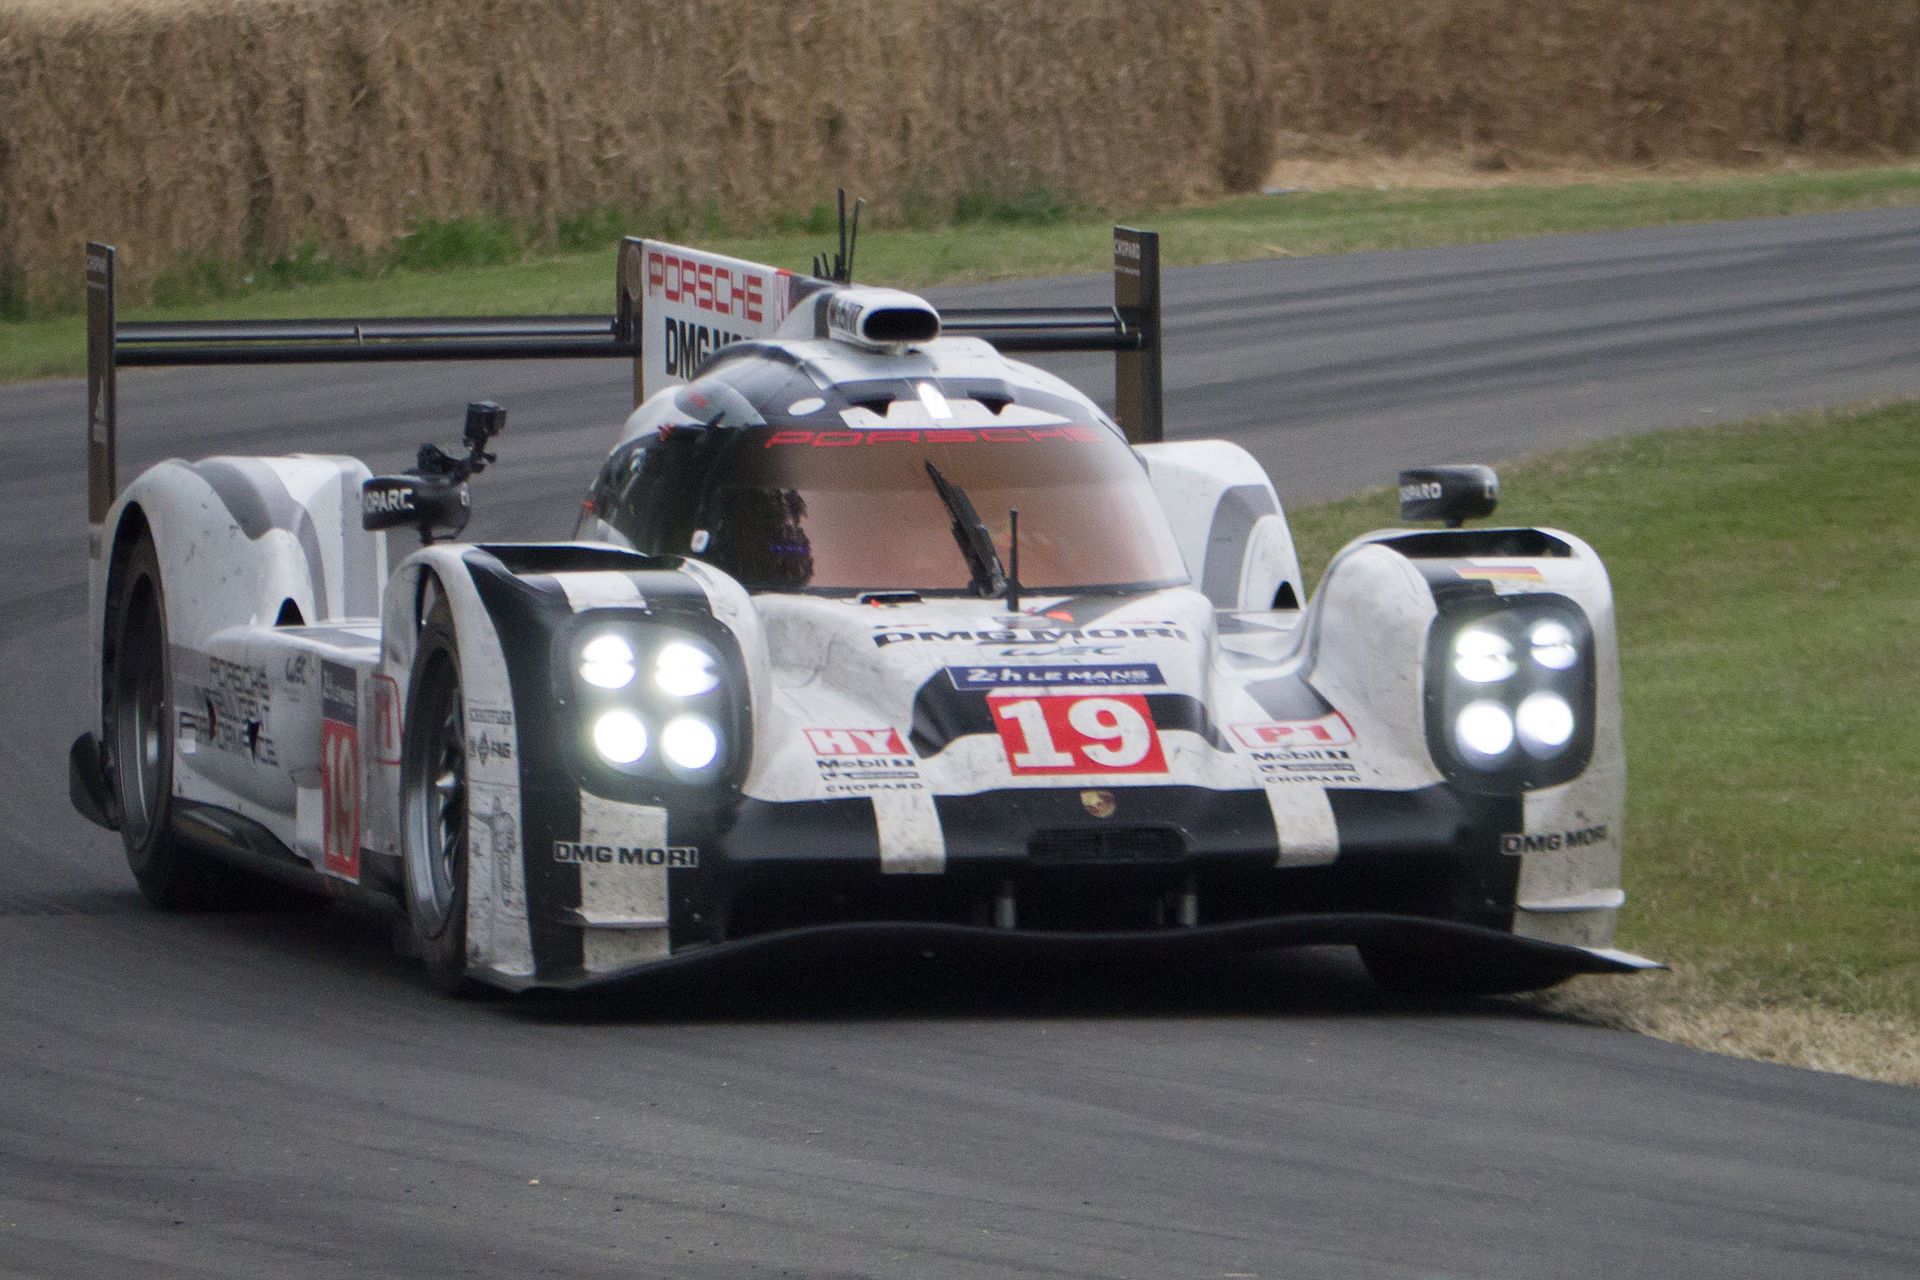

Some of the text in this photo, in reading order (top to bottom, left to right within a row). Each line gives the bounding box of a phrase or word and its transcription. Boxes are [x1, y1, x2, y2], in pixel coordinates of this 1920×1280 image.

[649, 252, 763, 323] PORSCHE
[764, 426, 1104, 448] PORSCHE
[872, 628, 1020, 648] DMG
[1026, 670, 1056, 681] LE
[1067, 669, 1151, 682] MANS
[805, 728, 897, 755] HY
[998, 697, 1151, 768] 19
[1254, 724, 1333, 744] P1
[816, 759, 888, 769] Mobil
[825, 782, 924, 793] CHOPARD
[1263, 774, 1362, 783] CHOPARD
[325, 733, 357, 861] 19
[1503, 832, 1561, 853] DMG
[554, 843, 697, 866] DMG MORI
